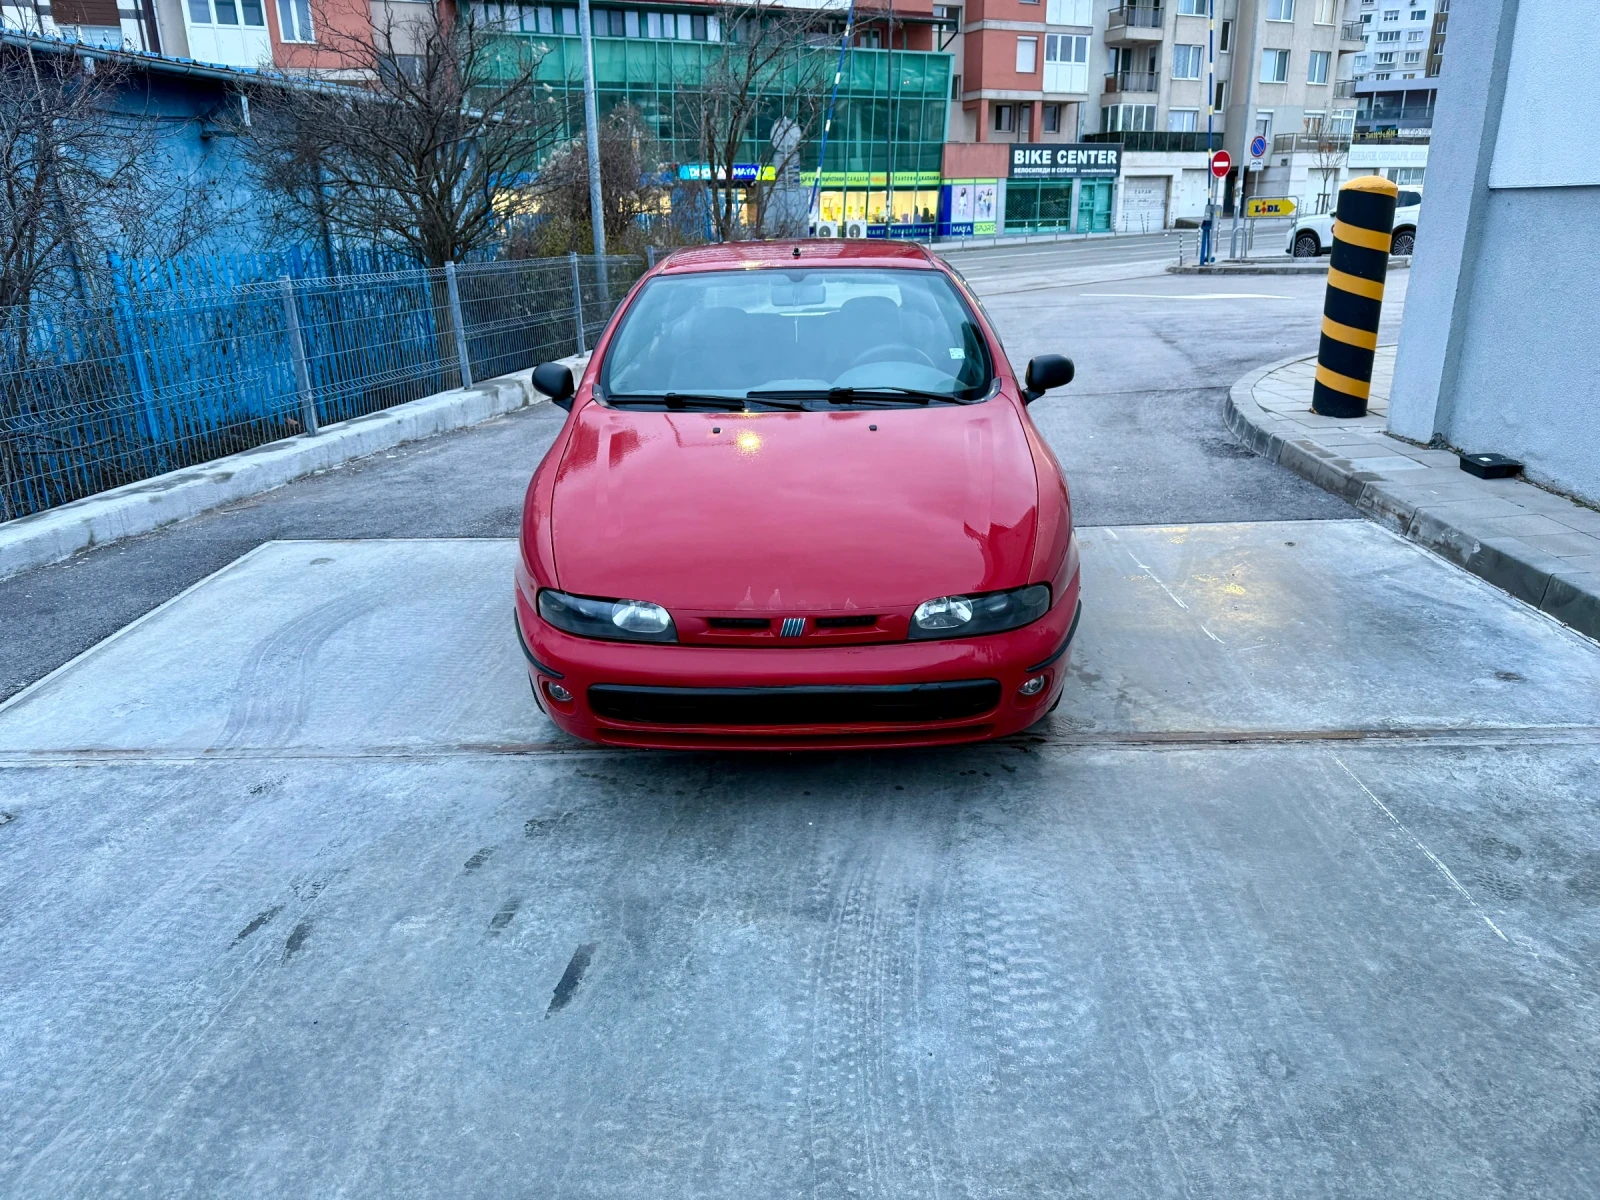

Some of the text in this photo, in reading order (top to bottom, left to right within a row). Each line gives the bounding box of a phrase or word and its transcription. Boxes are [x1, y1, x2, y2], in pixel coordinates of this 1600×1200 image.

[1013, 150, 1118, 164] BIKE CENTER
[952, 225, 972, 233] MAYA
[974, 224, 995, 232] SPORT
